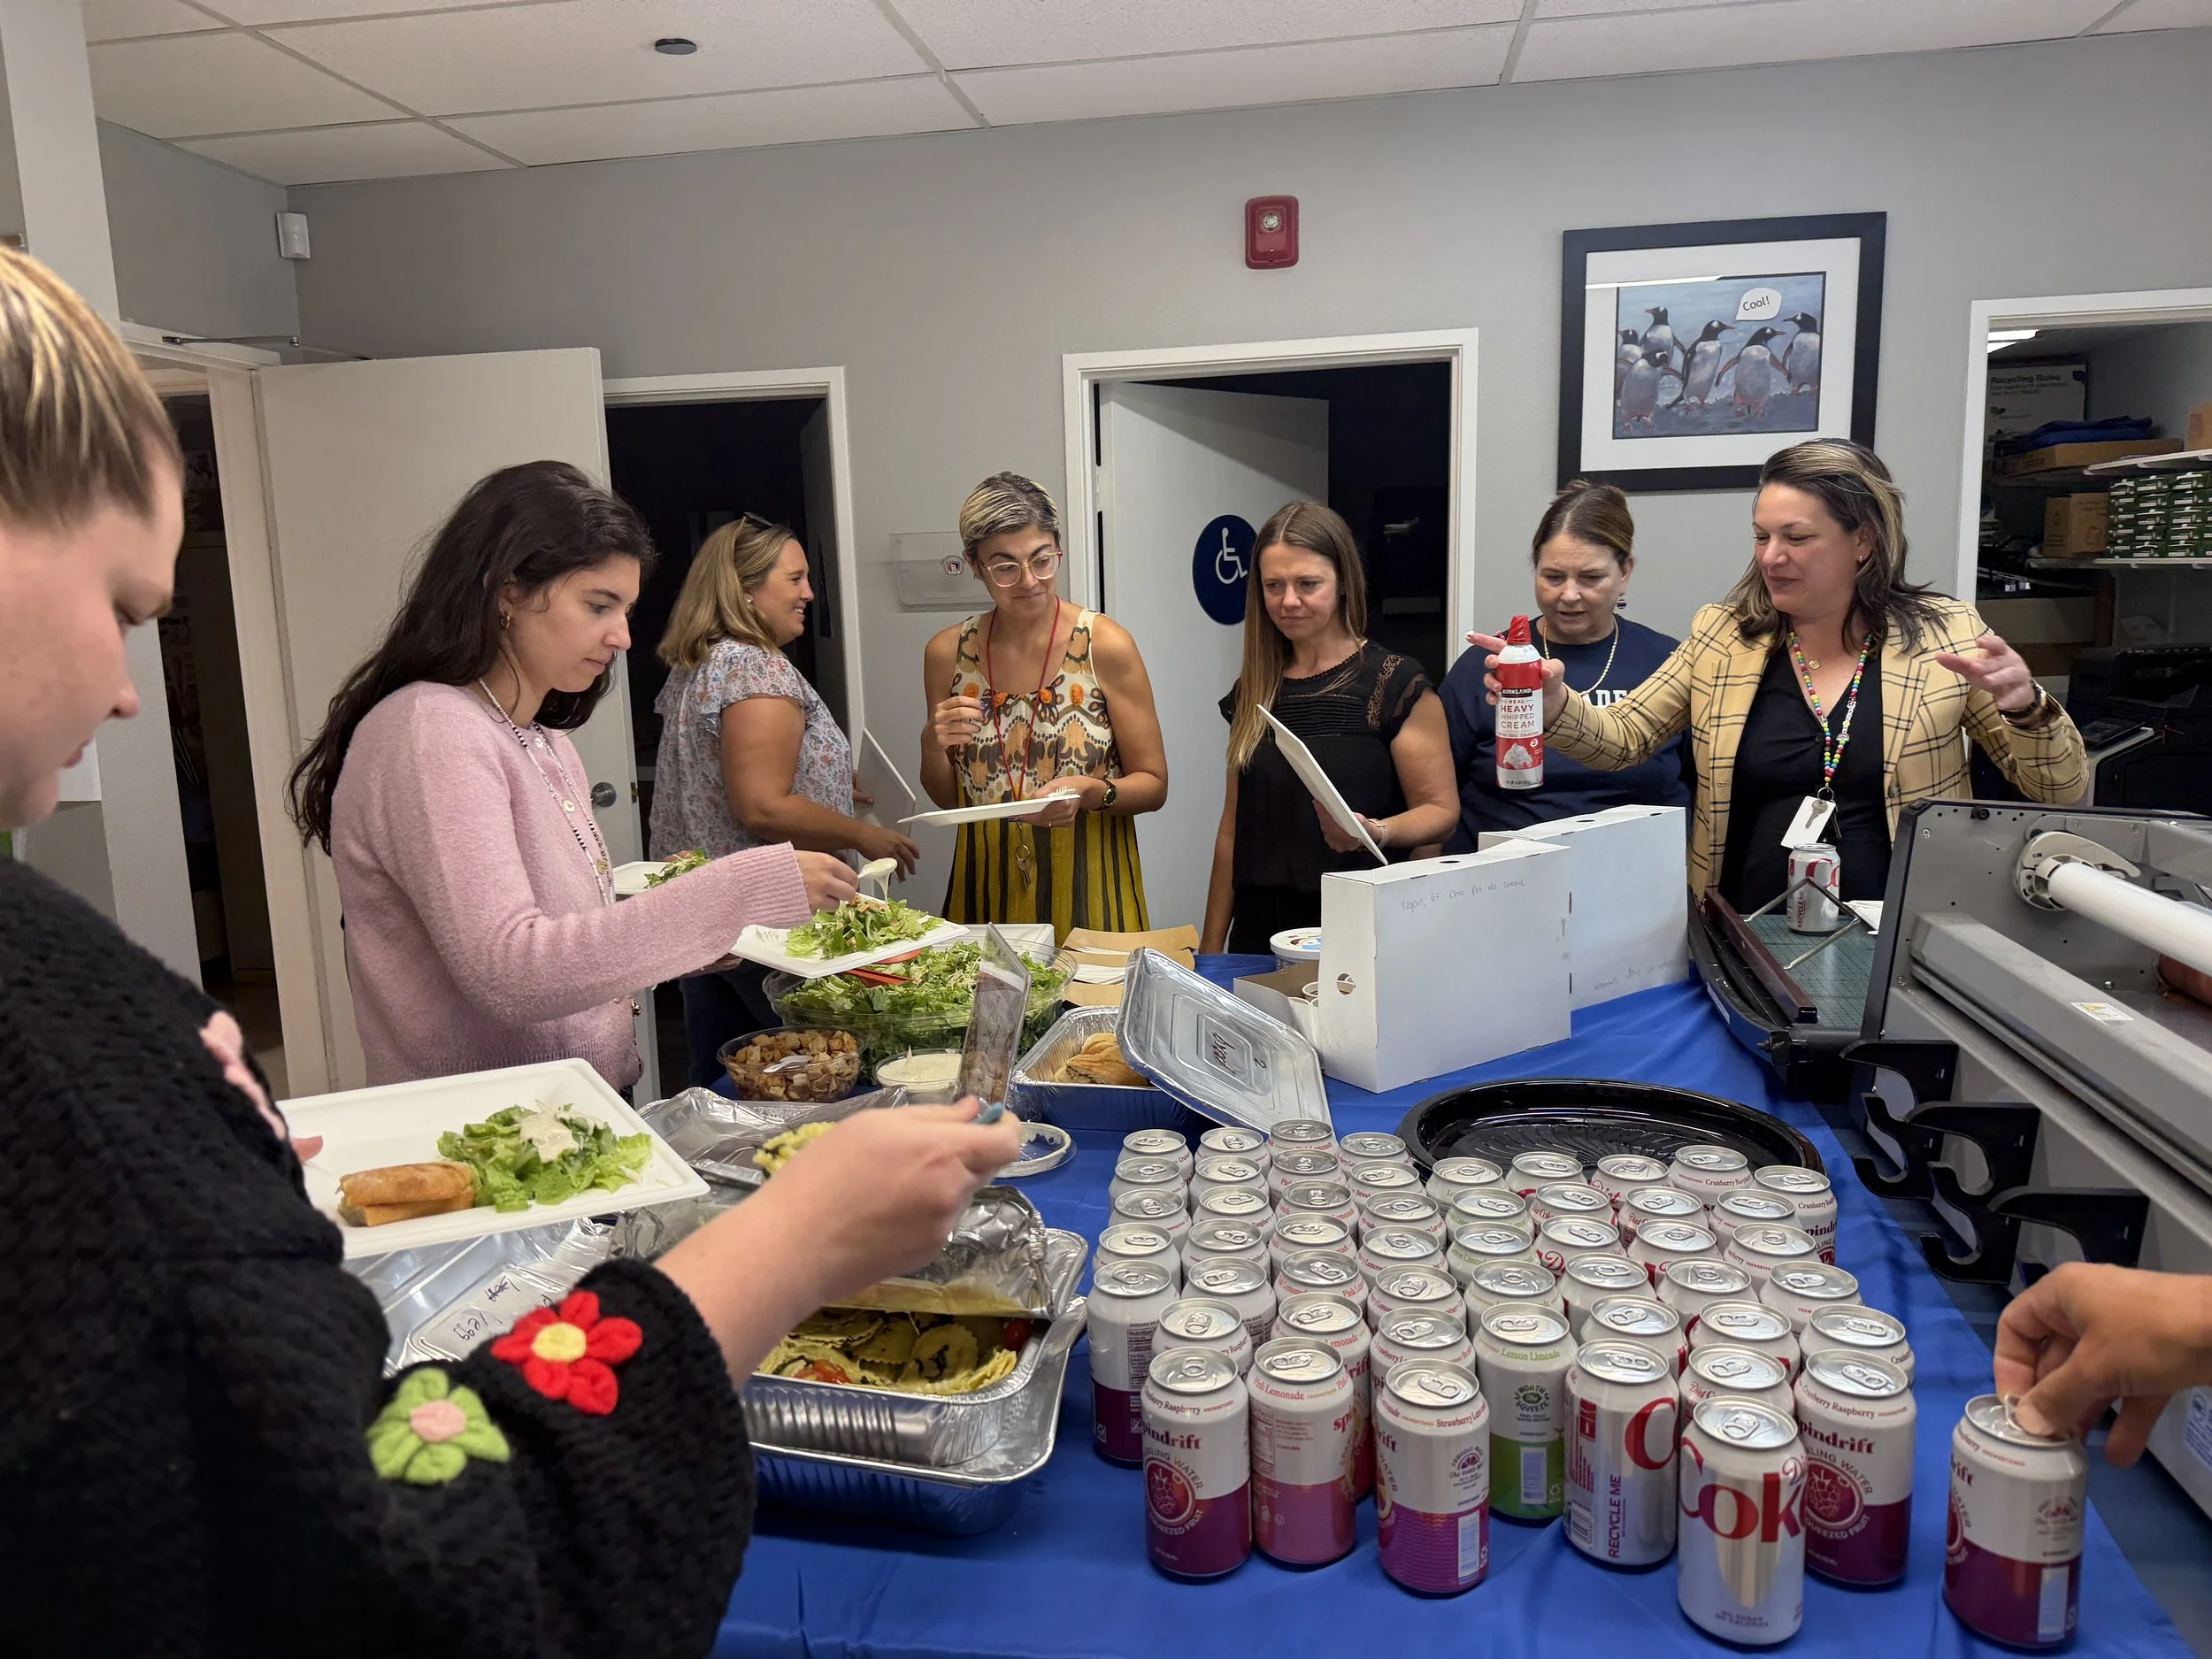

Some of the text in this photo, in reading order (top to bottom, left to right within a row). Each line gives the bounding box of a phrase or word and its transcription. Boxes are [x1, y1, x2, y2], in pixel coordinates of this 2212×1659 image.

[1743, 296, 1770, 311] Cool!
[1501, 720, 1534, 729] CREAM
[1501, 1348, 1561, 1361] Lemon Limeade
[1265, 1384, 1304, 1400] Lemonade
[1517, 1385, 1547, 1394] WORTH
[1164, 1400, 1201, 1416] Raspberry
[1515, 1400, 1550, 1412] SQUEEZE
[1832, 1402, 1875, 1419] Raspberry
[1436, 1416, 1472, 1428] Strawberry
[1798, 1419, 1875, 1454] pindrift
[1174, 1456, 1203, 1490] WATER
[1840, 1460, 1873, 1495] WATER
[1185, 1509, 1203, 1531] FRUIT
[1609, 1473, 1622, 1559] RECYCLE ME
[1848, 1513, 1871, 1537] FRUIT
